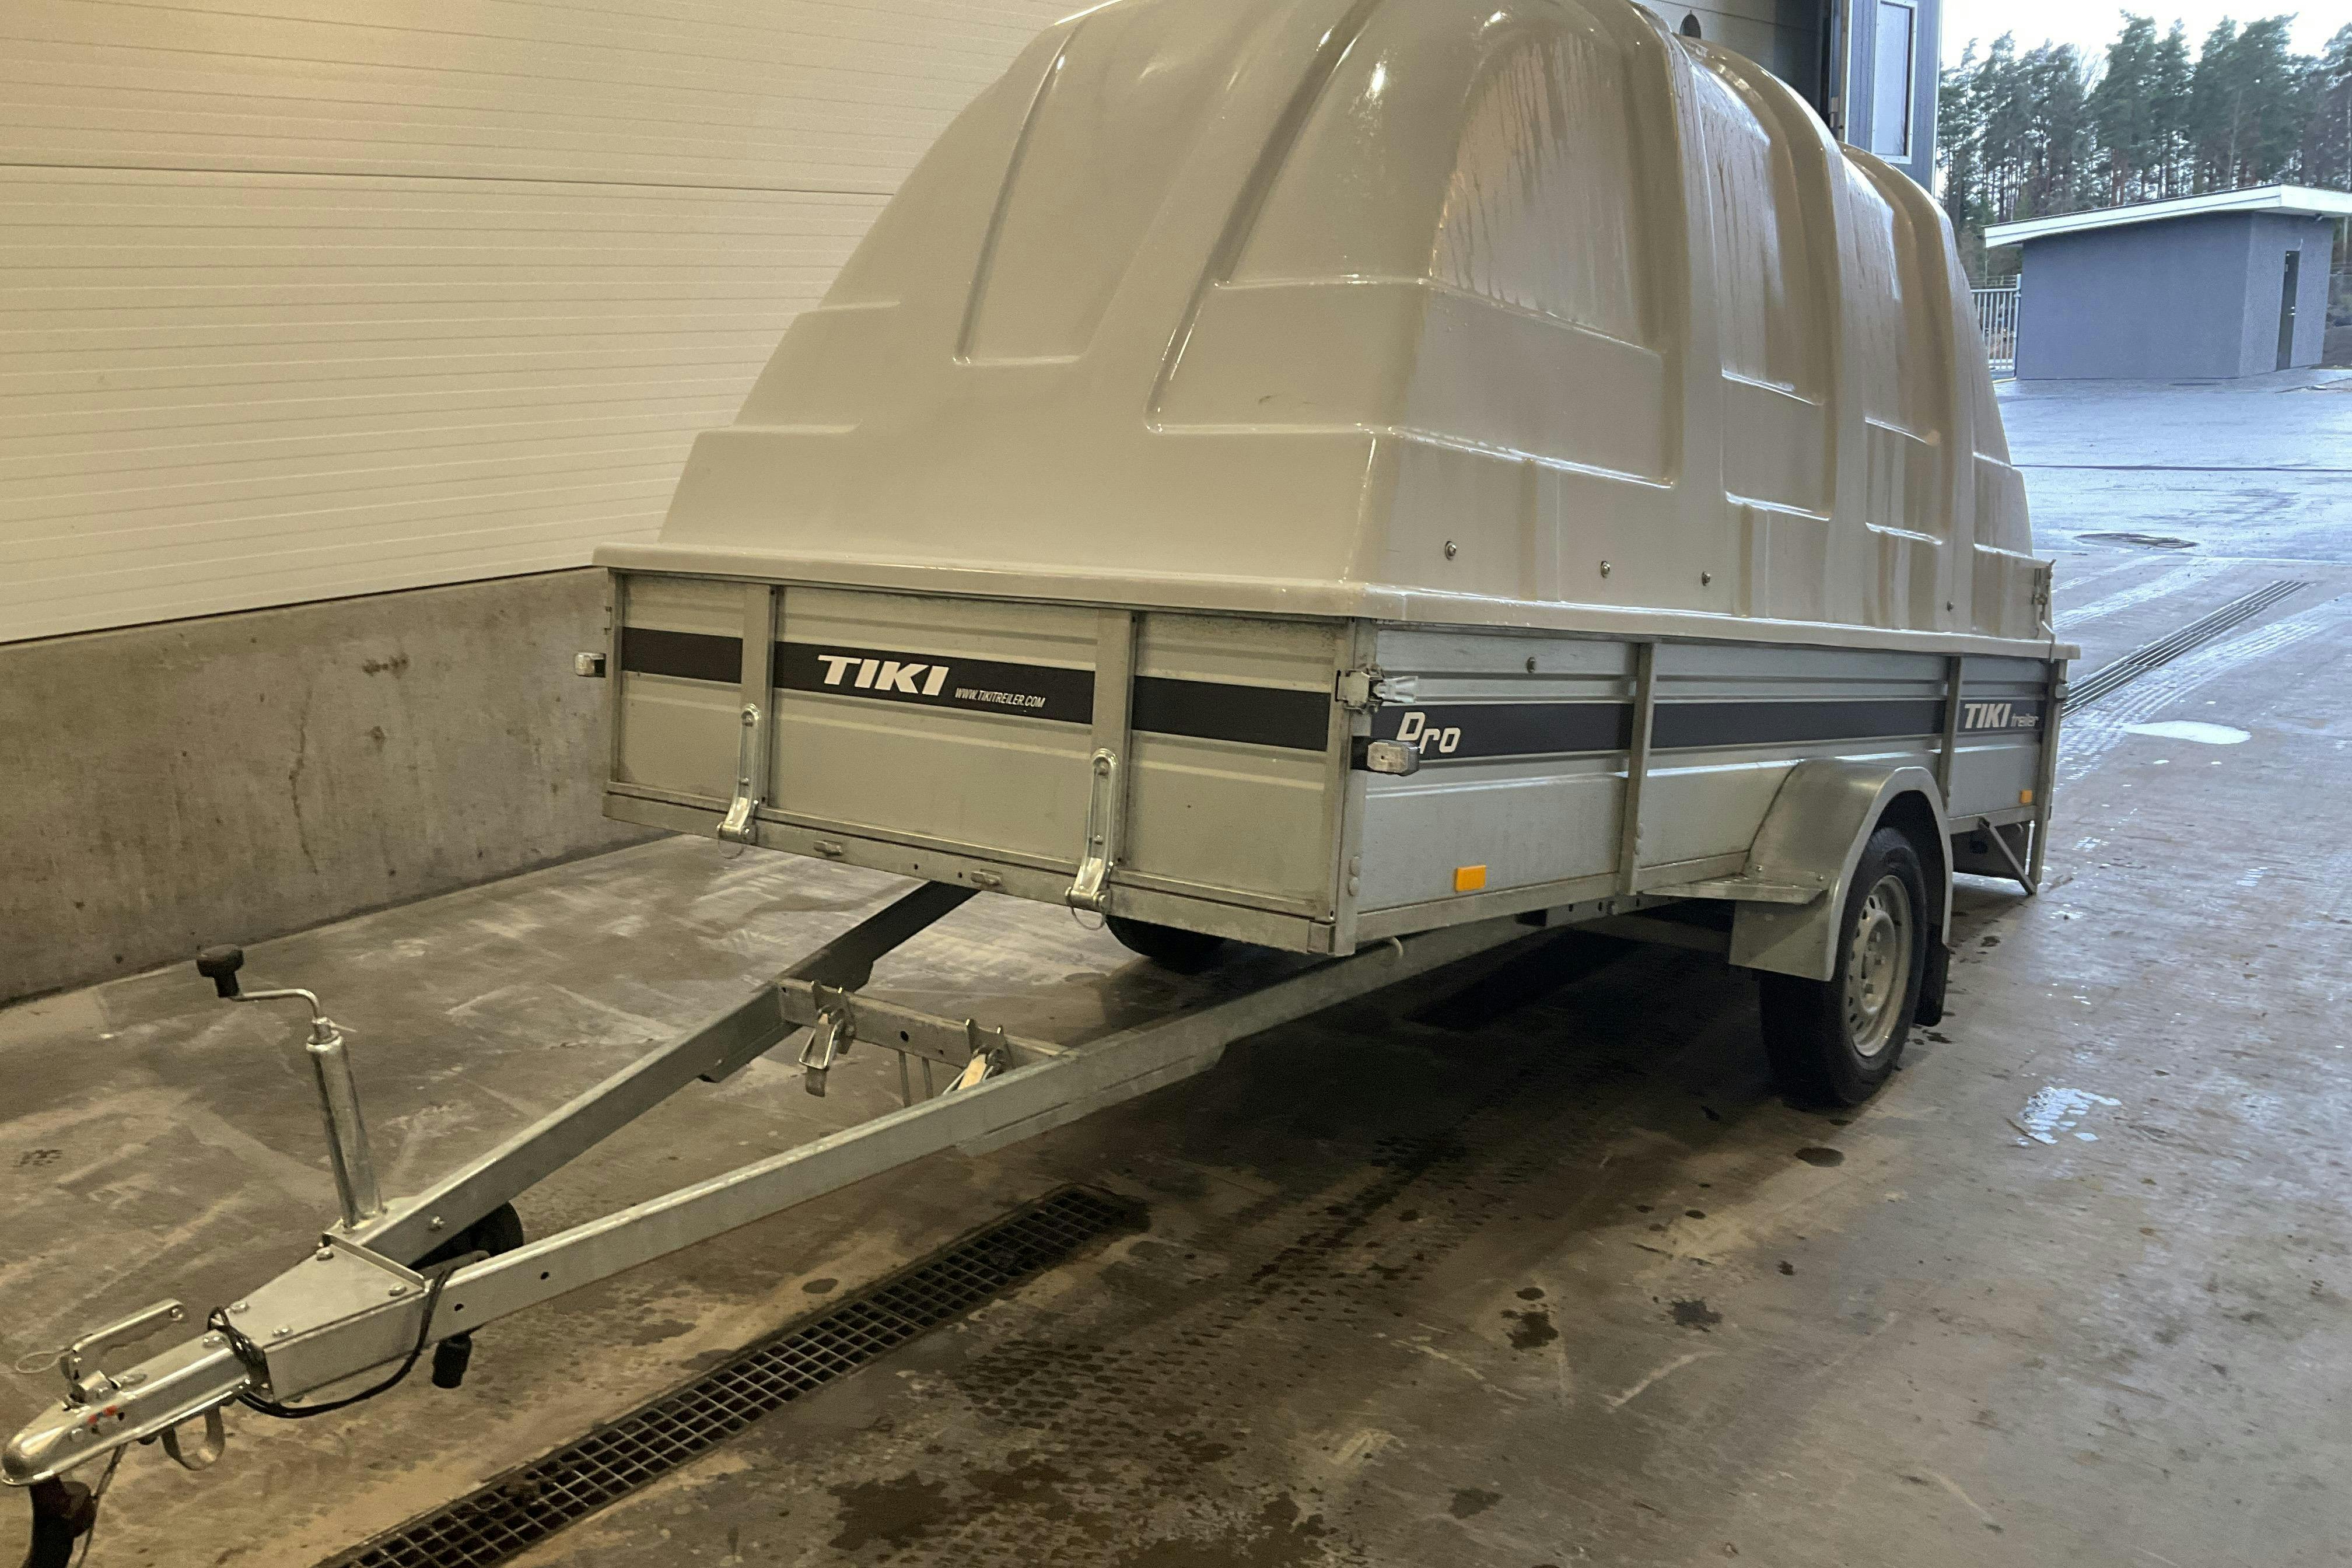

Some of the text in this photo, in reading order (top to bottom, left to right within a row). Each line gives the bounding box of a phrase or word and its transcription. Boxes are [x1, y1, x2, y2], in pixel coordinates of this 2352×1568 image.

[818, 654, 1046, 708] TIKI WWW.TIKITREILER.COM
[1965, 704, 2012, 729] TIKI
